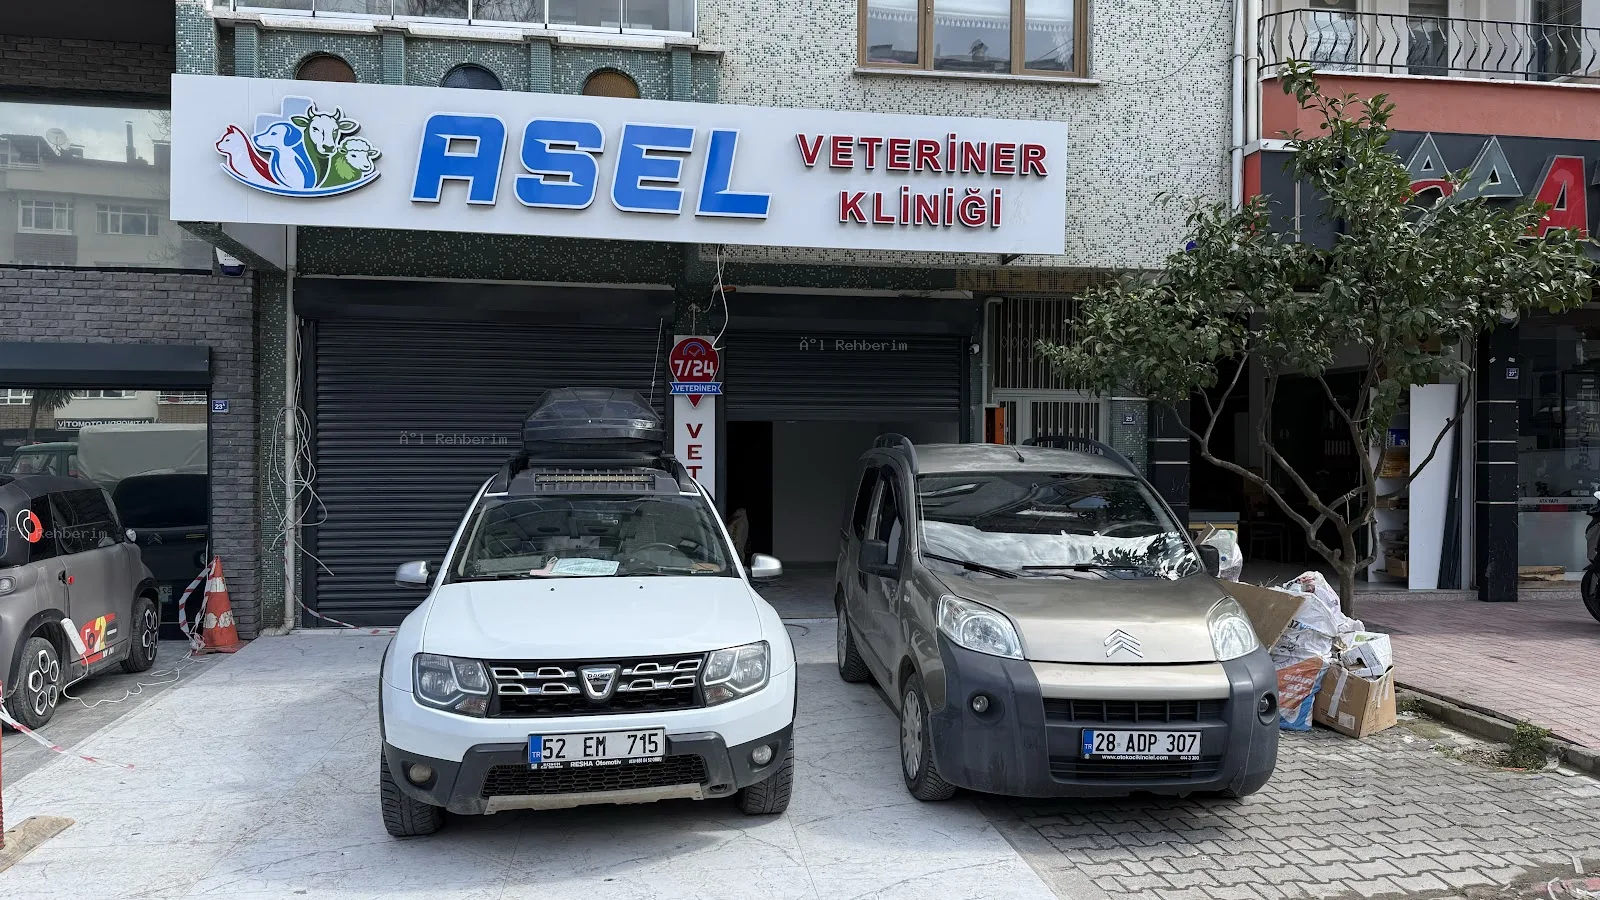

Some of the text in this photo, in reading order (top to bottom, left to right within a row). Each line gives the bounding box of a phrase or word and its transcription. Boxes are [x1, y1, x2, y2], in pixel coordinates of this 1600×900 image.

[410, 111, 772, 219] ASEL
[796, 132, 1048, 176] VETERİNER
[838, 185, 1003, 228] KLİNİĞİ
[674, 359, 715, 377] 7/24
[675, 384, 718, 392] VETERİNER
[542, 732, 659, 760] 52 EM 715
[1095, 733, 1197, 753] 28 ADP 307
[570, 760, 593, 768] RESHA
[595, 759, 622, 767] Otomotiv
